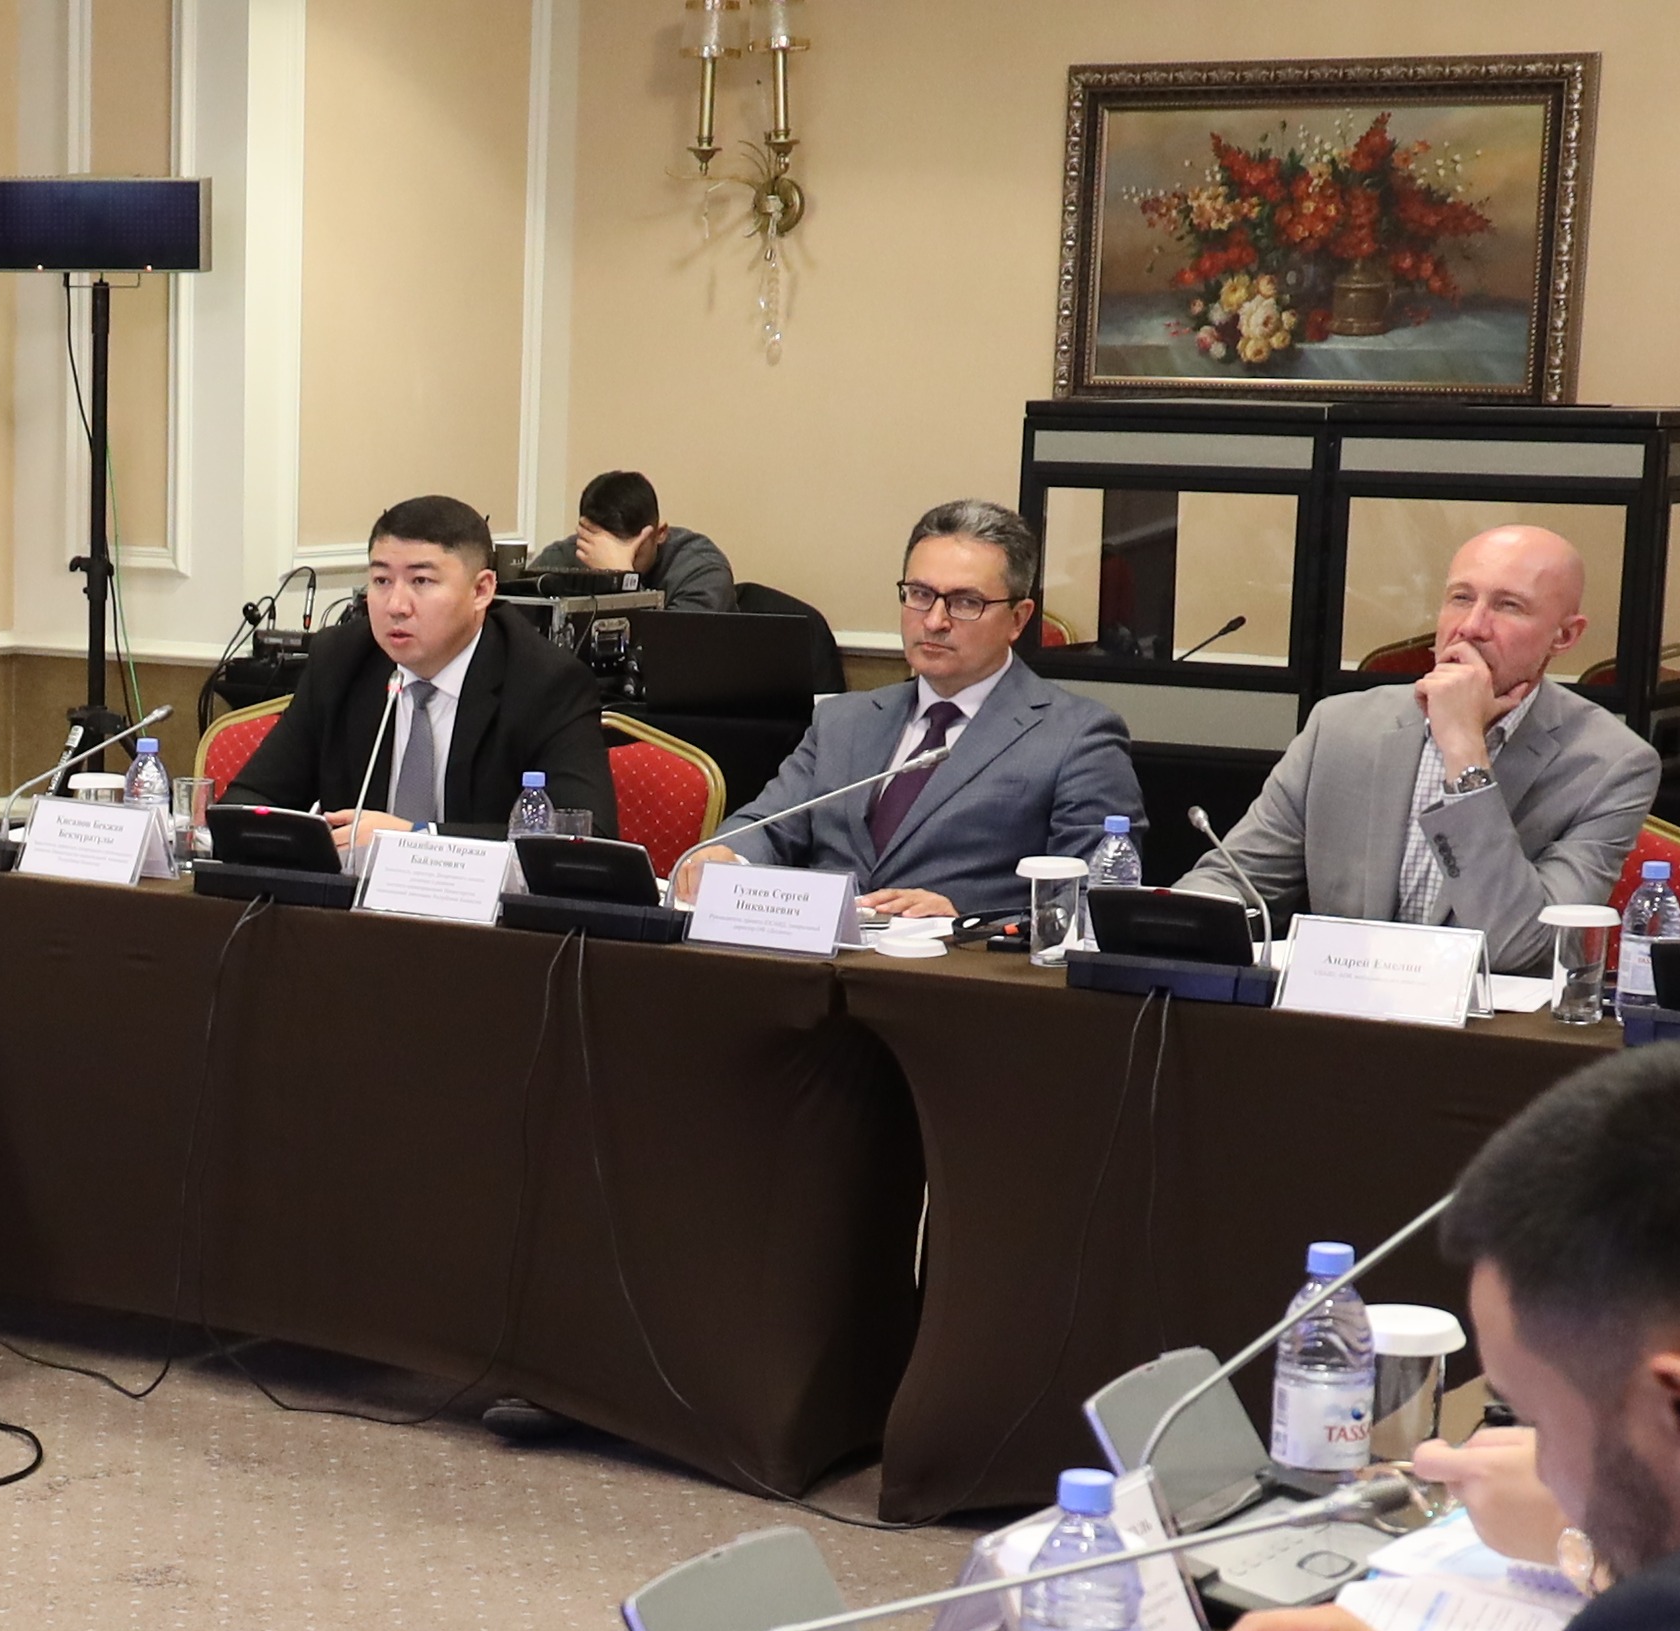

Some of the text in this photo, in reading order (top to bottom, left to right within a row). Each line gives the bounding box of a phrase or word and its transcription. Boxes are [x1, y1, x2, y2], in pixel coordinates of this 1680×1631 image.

[733, 883, 810, 903] Гуляев Сергей
[735, 899, 801, 917] Николаевич
[1323, 954, 1370, 969] Андрей
